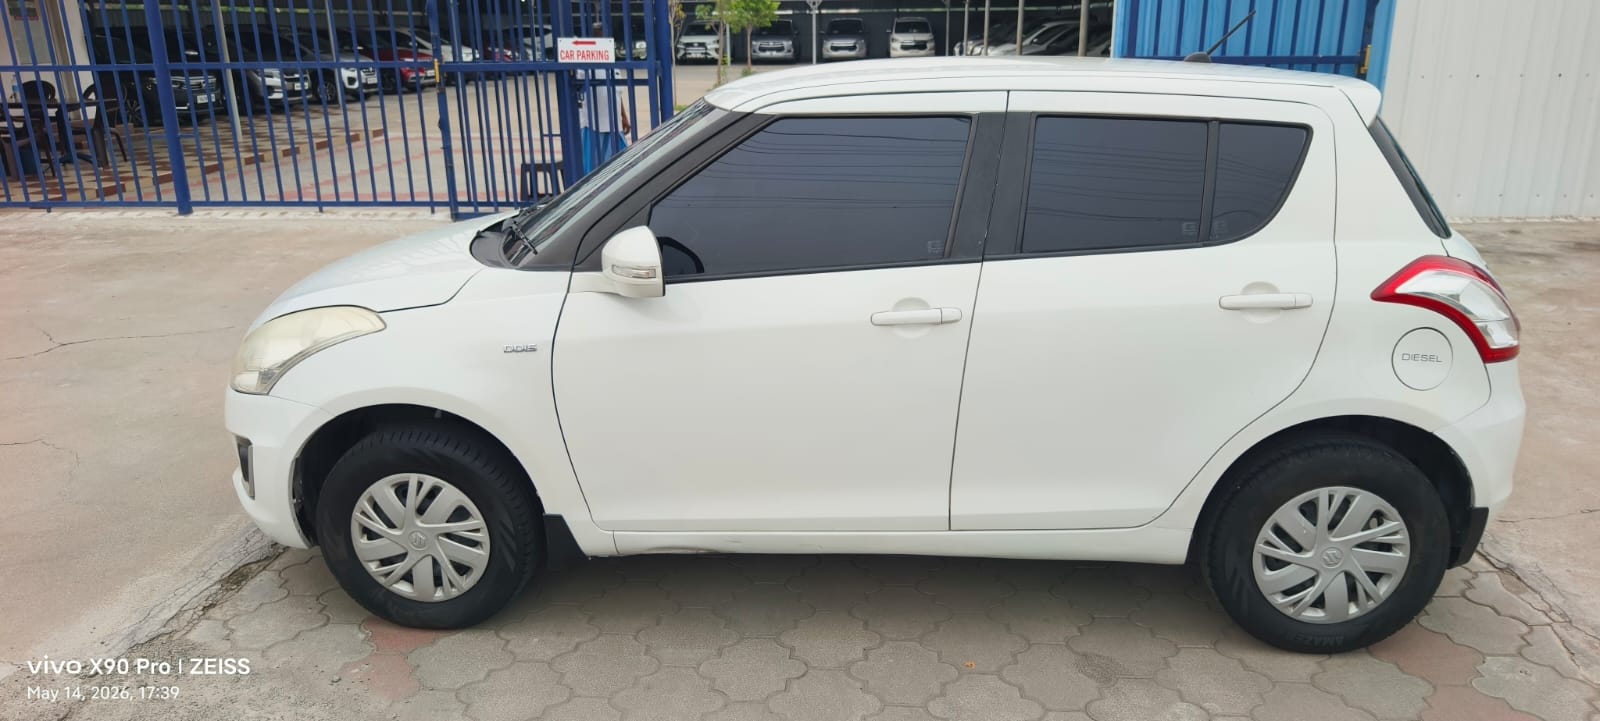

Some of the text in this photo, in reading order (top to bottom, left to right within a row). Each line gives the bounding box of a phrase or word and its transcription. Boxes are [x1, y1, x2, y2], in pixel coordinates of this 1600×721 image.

[560, 50, 610, 61] CAR PARKING
[1401, 353, 1443, 363] DIESEL
